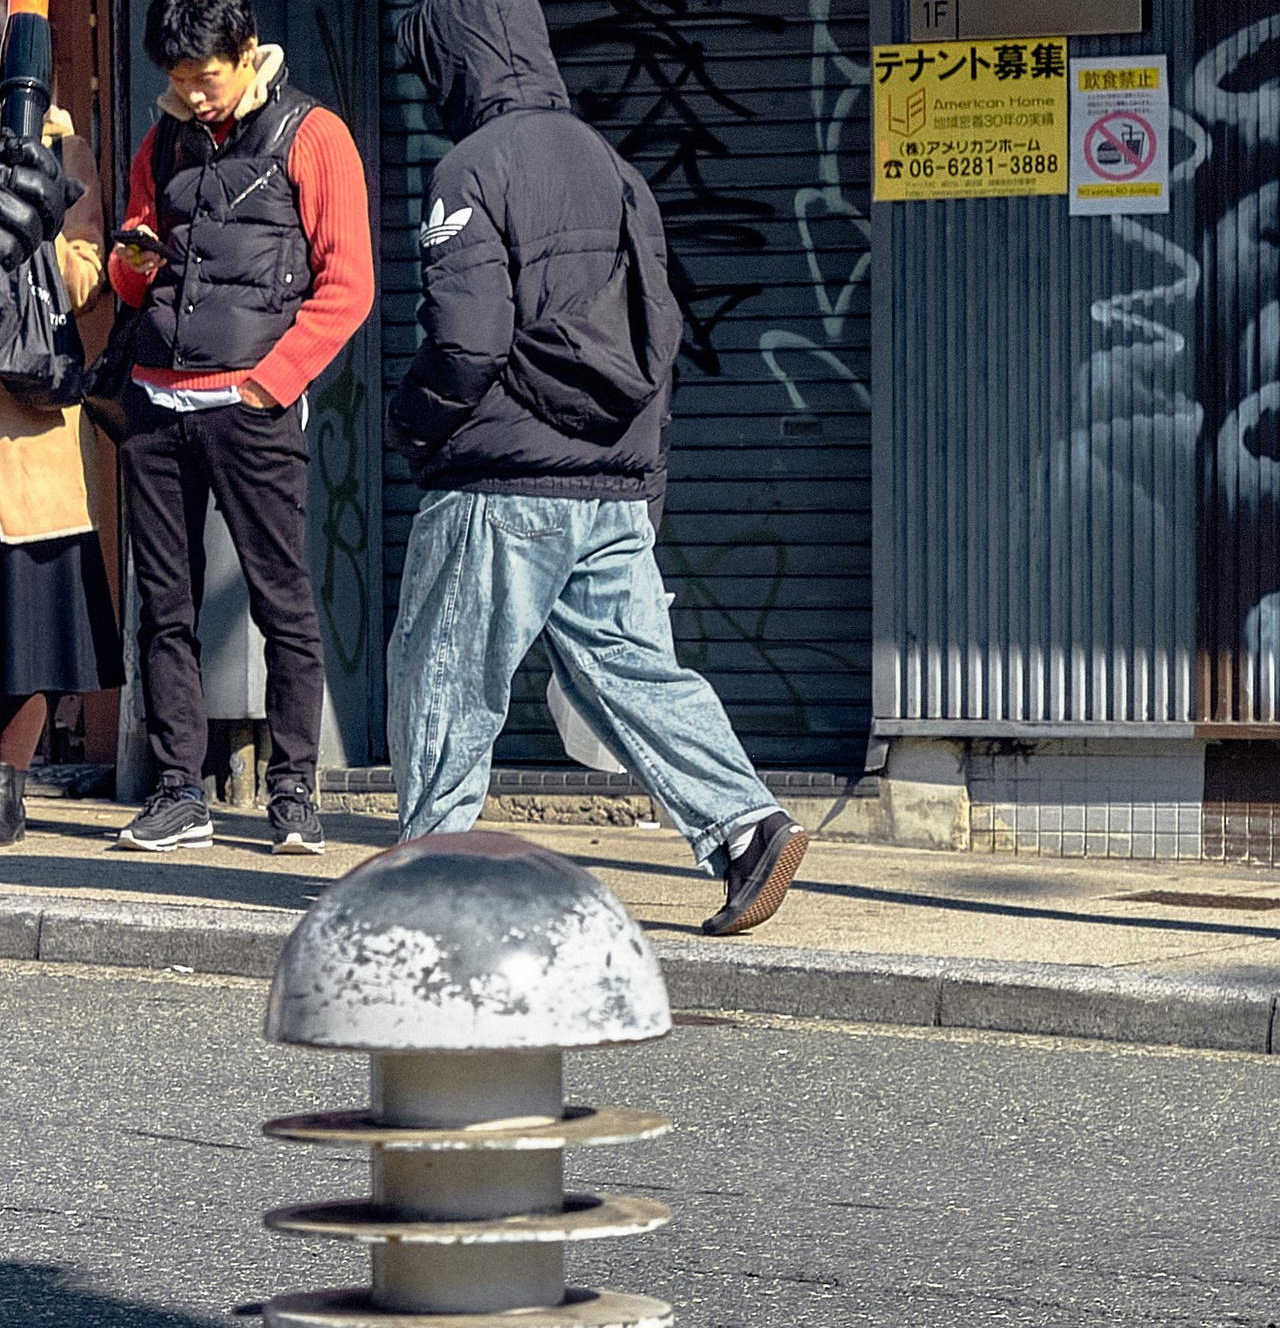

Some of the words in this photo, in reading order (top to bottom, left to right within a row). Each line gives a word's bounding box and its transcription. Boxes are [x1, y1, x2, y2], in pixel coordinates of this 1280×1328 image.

[922, 0, 948, 29] 1F
[875, 42, 1066, 85] テナント募集
[1084, 69, 1154, 90] 飲食禁止
[933, 97, 1005, 111] American
[1009, 94, 1055, 108] Home
[909, 154, 1059, 178] 06-6281-3888
